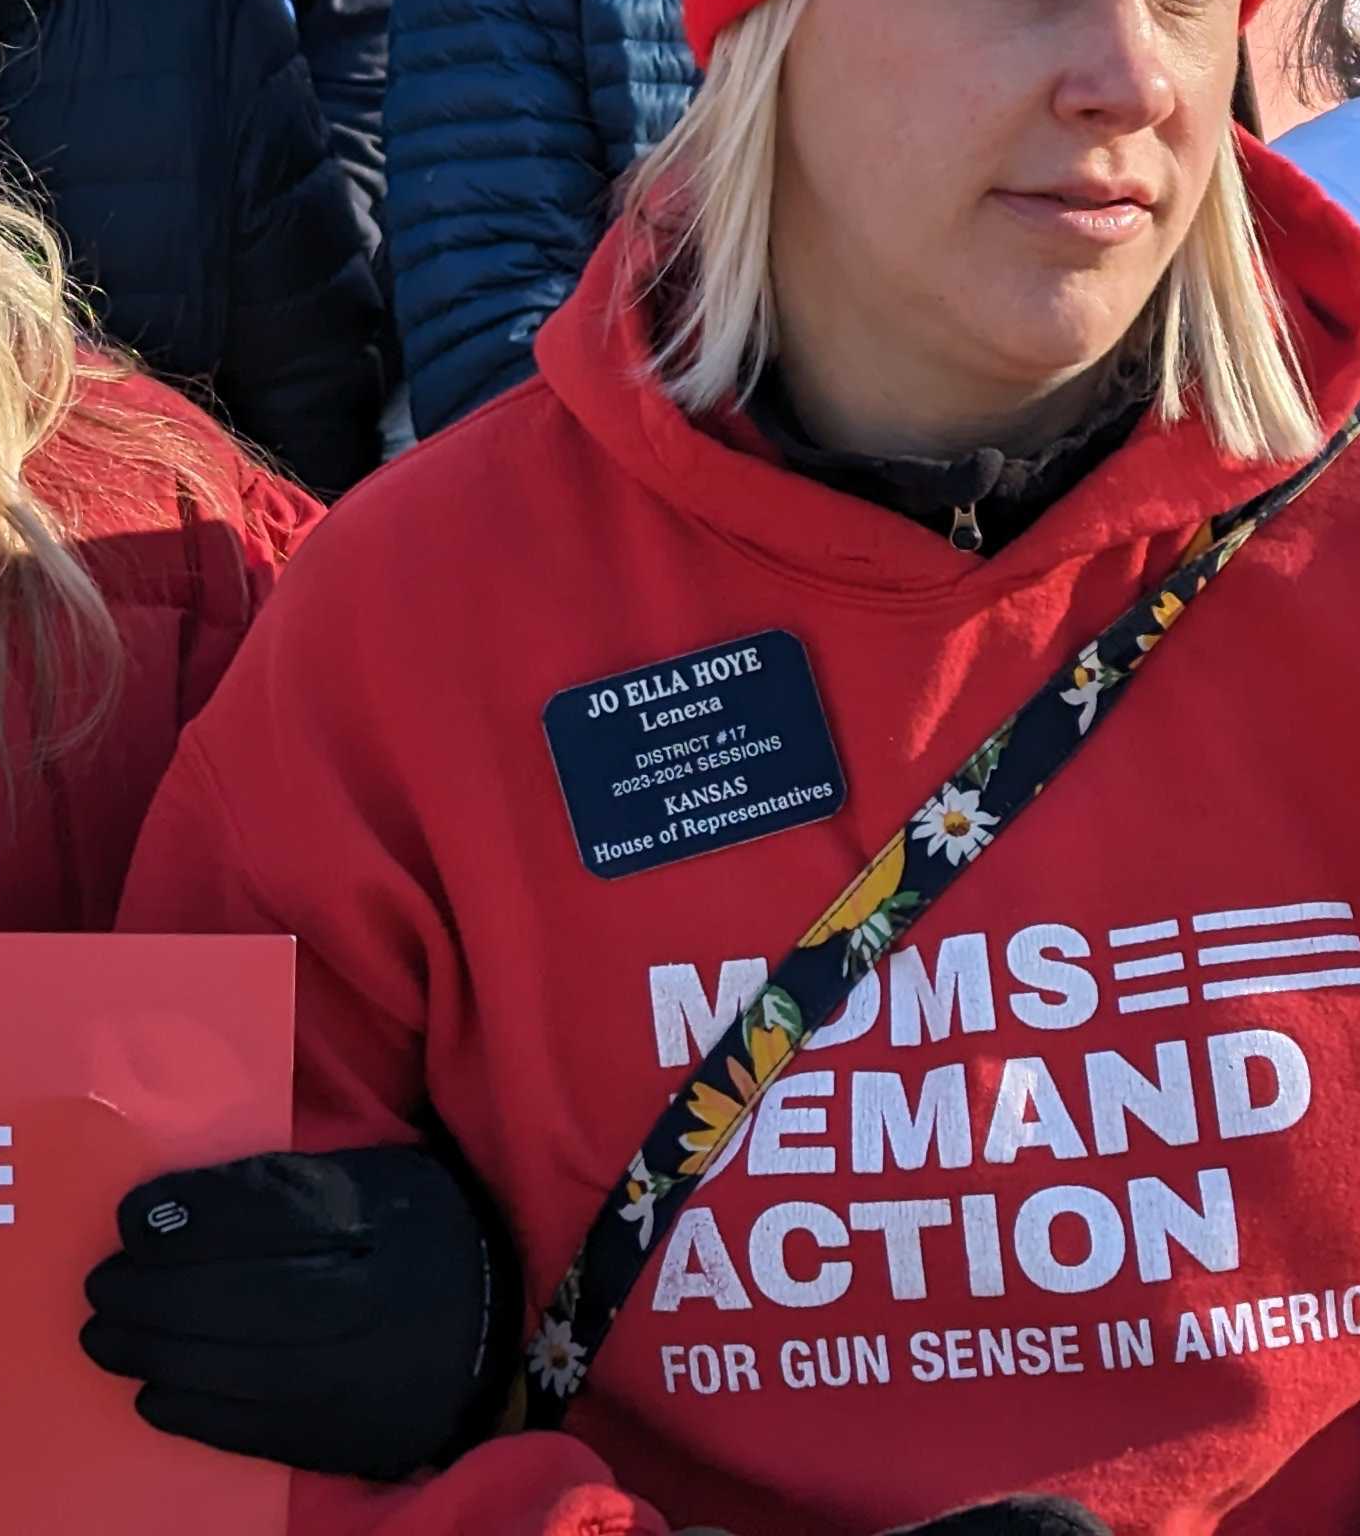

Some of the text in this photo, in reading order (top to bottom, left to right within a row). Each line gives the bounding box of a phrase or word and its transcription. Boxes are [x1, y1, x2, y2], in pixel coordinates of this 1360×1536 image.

[587, 647, 762, 719] JO ELLA HOYE
[639, 695, 723, 732] Lenexa
[612, 735, 782, 797] 2023-2024 SESSIONS
[635, 724, 748, 769] DISTRICT #17
[593, 781, 833, 863] House of Representatives
[664, 775, 748, 815] KANSAS
[670, 1028, 1311, 1190] EMAND
[651, 1167, 1240, 1312] ACTION
[661, 1340, 761, 1395] FOR
[780, 1334, 891, 1388] GUN
[910, 1325, 1084, 1383] SENSE
[1098, 1321, 1155, 1371] IN
